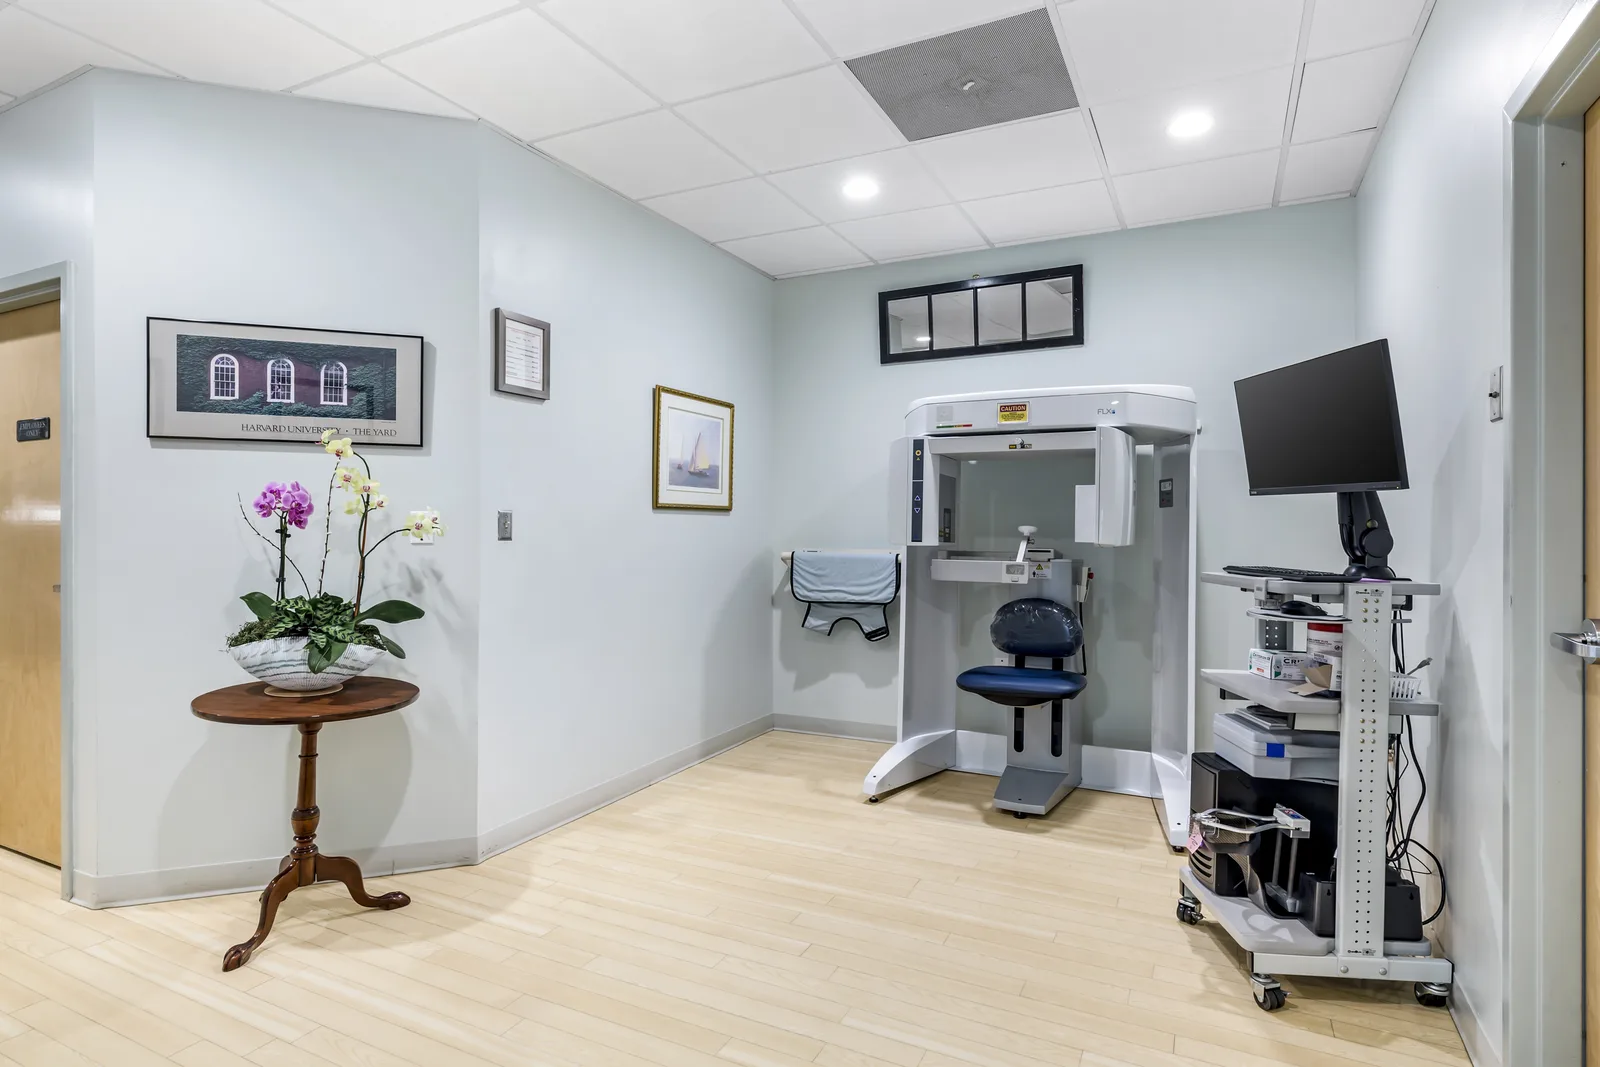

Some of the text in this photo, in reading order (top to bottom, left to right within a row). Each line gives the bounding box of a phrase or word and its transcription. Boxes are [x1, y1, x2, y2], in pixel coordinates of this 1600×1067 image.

[241, 423, 286, 433] HARVARD
[353, 427, 371, 436] THE
[373, 428, 397, 437] YARD
